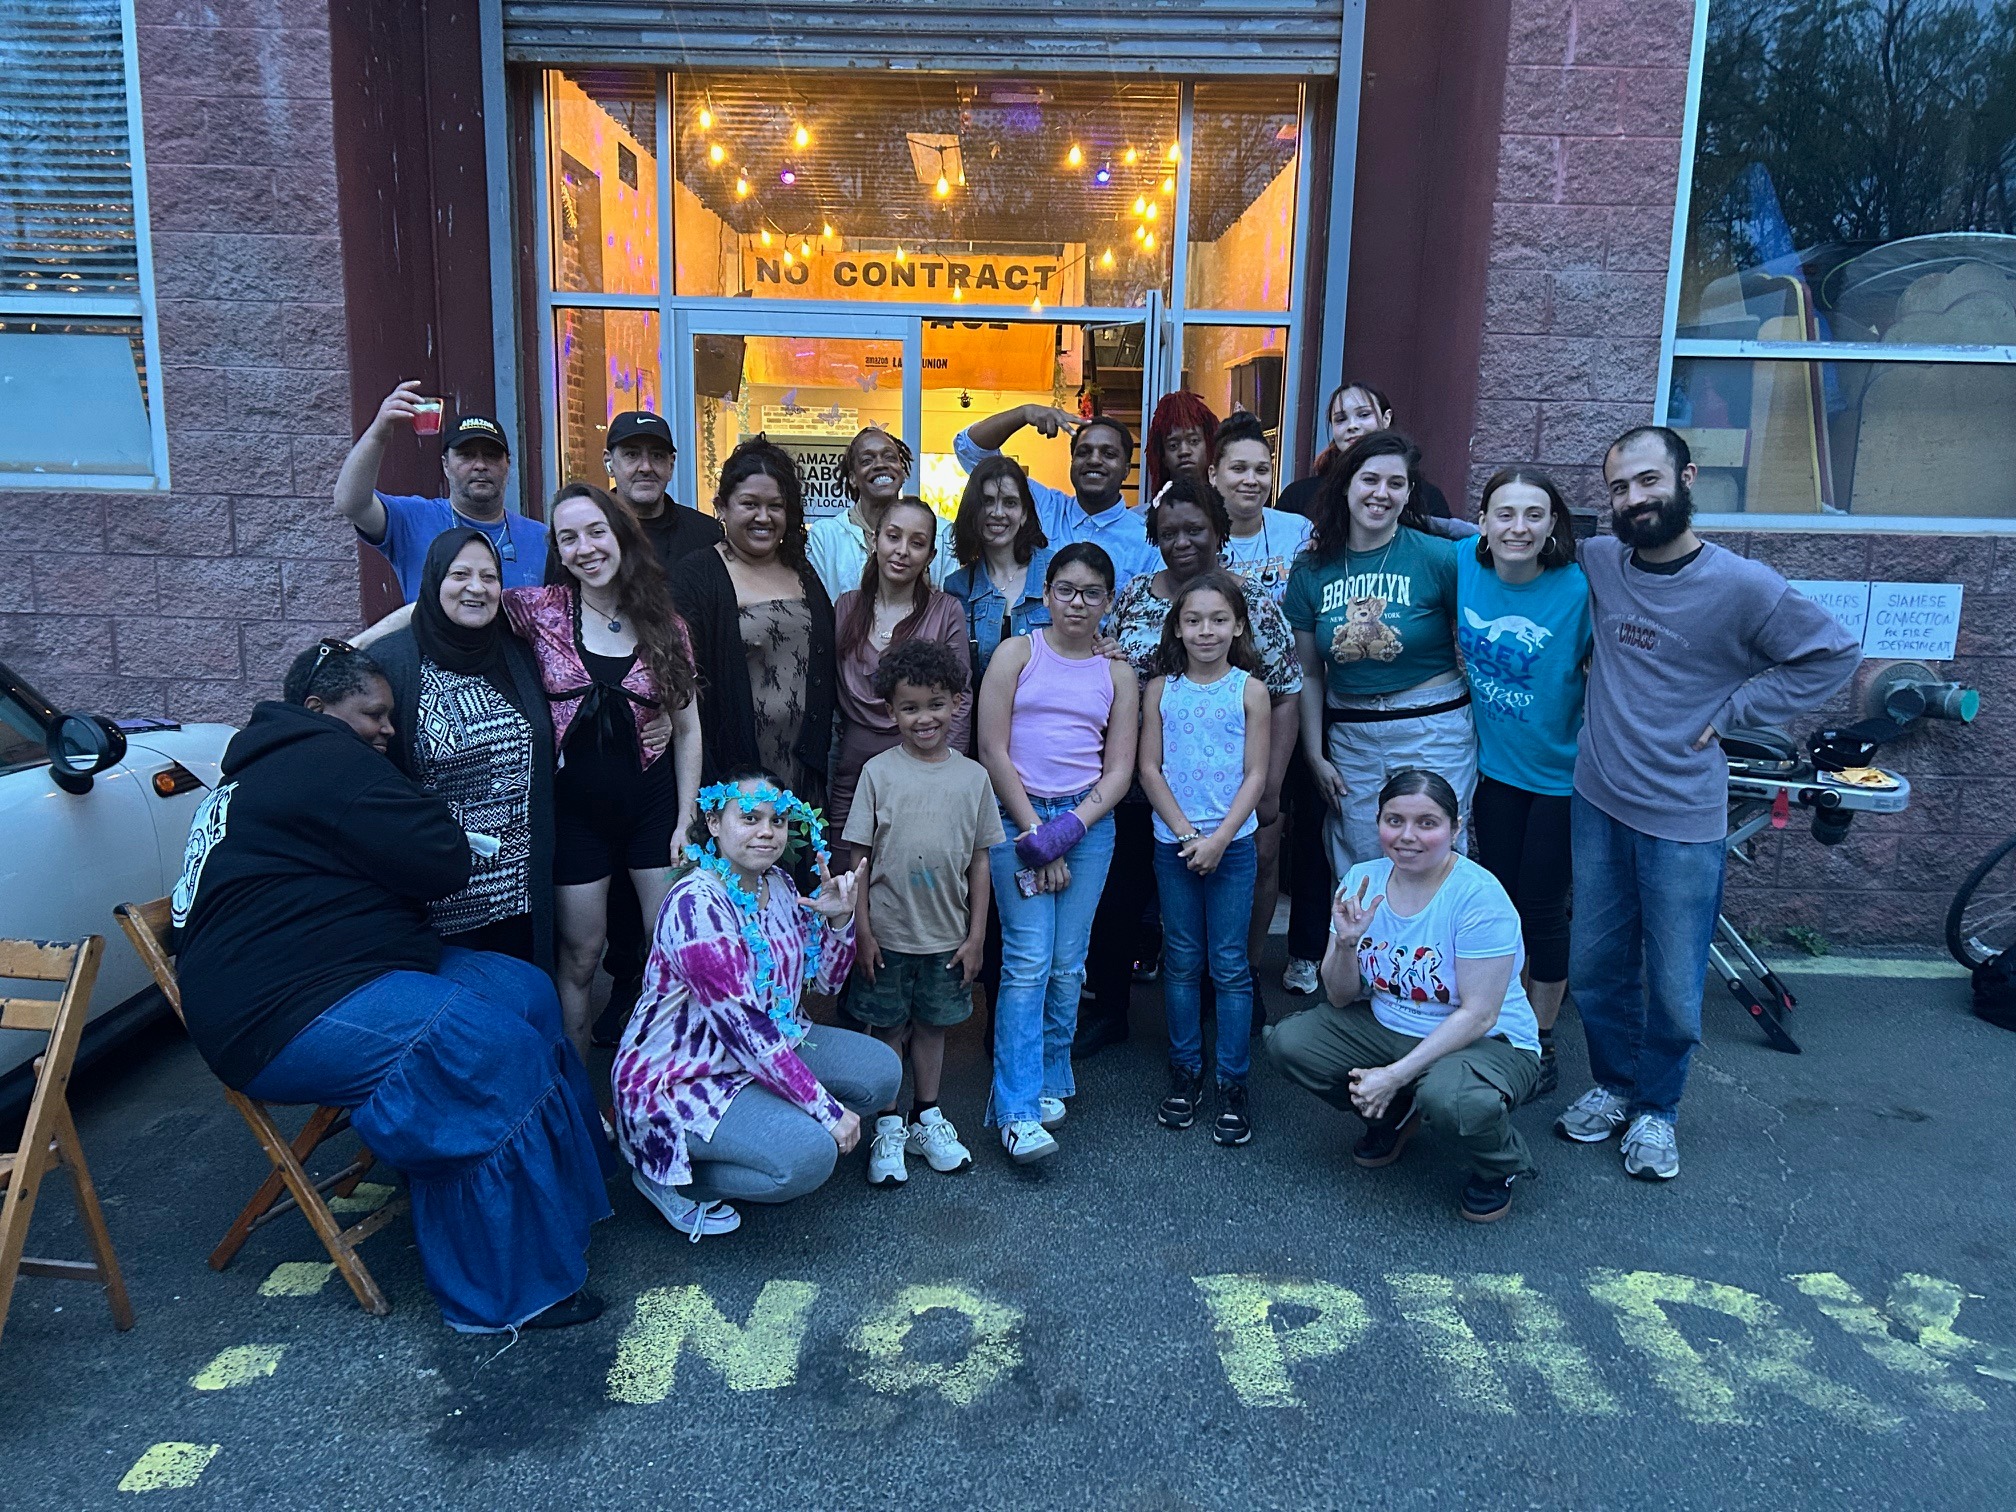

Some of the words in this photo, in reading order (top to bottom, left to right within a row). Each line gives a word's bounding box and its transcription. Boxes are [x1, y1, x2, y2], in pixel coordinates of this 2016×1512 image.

[756, 256, 809, 285] NO
[833, 260, 1057, 291] CONTRACT
[922, 358, 948, 369] UNION
[461, 418, 495, 430] AMAZON
[796, 453, 845, 465] AMAZ
[801, 466, 842, 481] ABO
[800, 482, 849, 498] UNIO
[802, 498, 814, 507] BT
[817, 498, 851, 508] LOCAL
[1320, 573, 1411, 614] BROOKLYN
[1887, 594, 1947, 608] SIAMESE
[1383, 611, 1401, 619] YORK
[1876, 610, 1955, 627] CONNECTION
[1902, 628, 1934, 638] FIRE
[1458, 625, 1541, 673] GREY
[1877, 640, 1952, 652] DEPARTMENT
[605, 1278, 1026, 1407] NO
